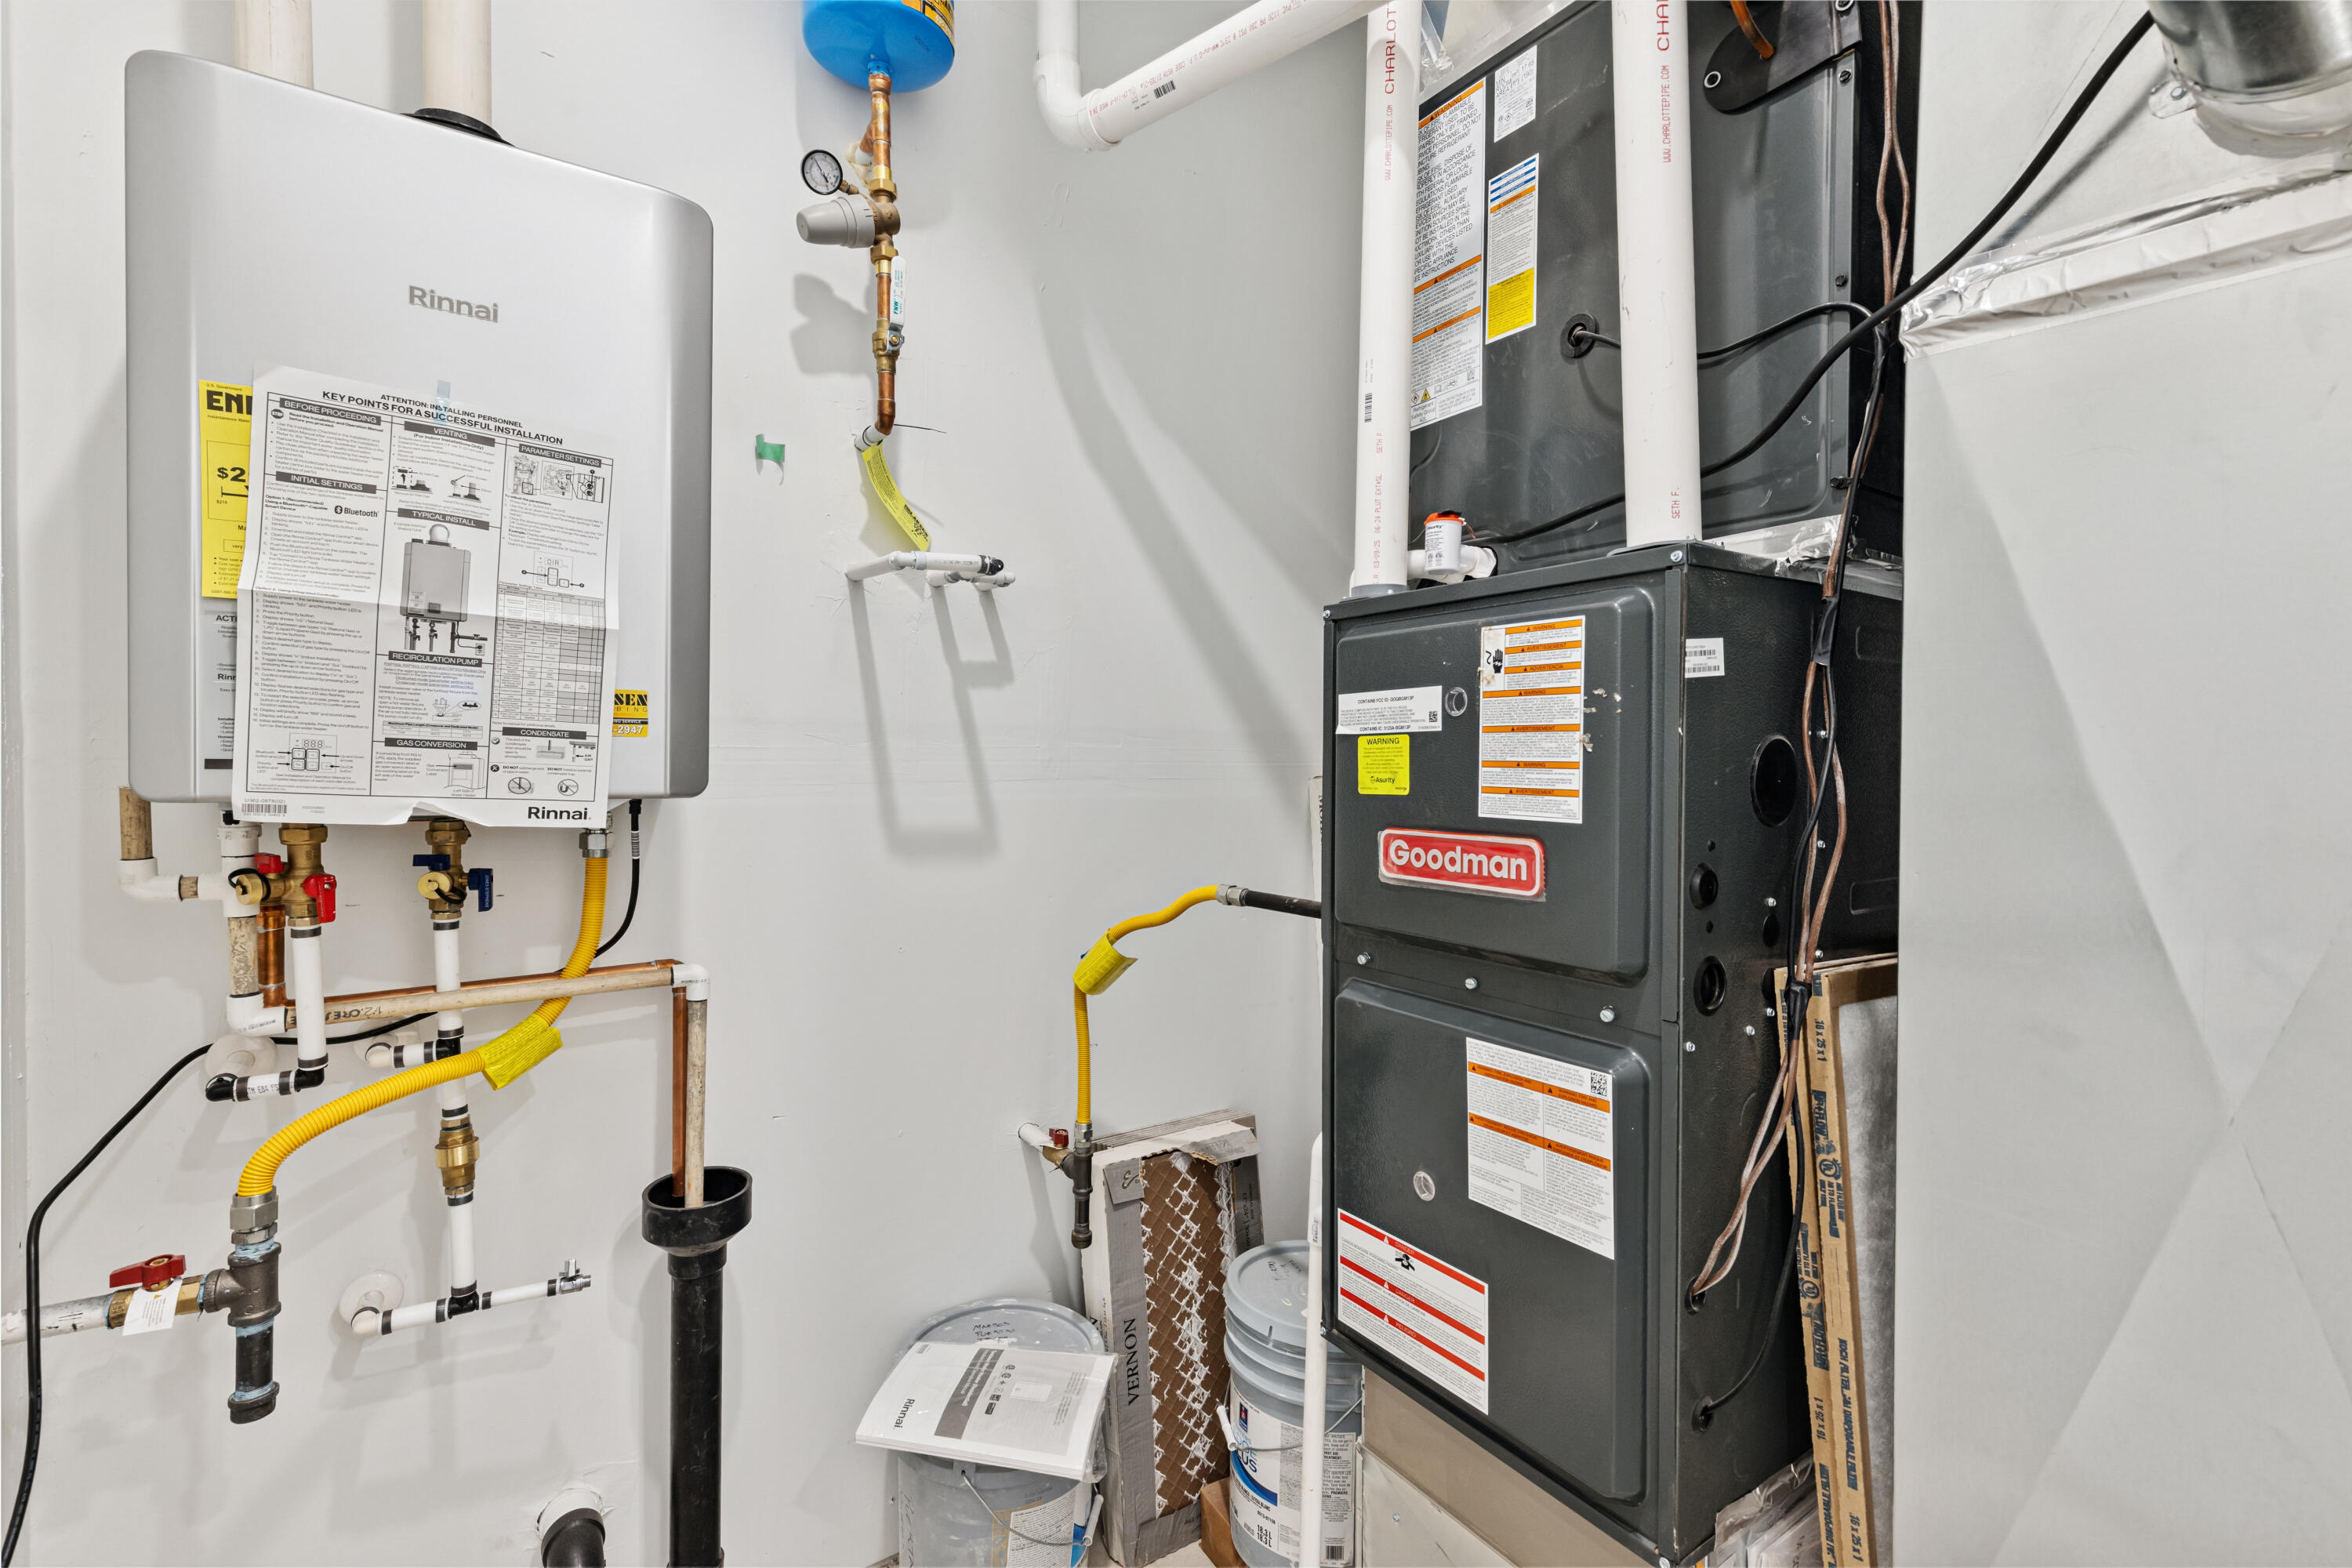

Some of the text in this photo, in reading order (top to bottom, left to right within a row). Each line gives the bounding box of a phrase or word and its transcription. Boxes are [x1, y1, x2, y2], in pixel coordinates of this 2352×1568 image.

[1656, 0, 1670, 51] CHA
[1435, 95, 1461, 116] WARNING
[1457, 109, 1477, 125] TRAINED
[1472, 114, 1481, 125] NOT
[1661, 65, 1671, 163] WWW.CHARLOTTEPIPE.COM
[1438, 129, 1470, 154] REFRIGERANT
[1444, 149, 1465, 165] DISPOSE
[1445, 167, 1472, 187] FLAMMABLE
[1454, 163, 1468, 176] LOCAL
[1432, 207, 1446, 219] WHICH
[1448, 201, 1458, 209] MAY
[1433, 201, 1471, 227] SOURCES SHALL
[1461, 209, 1470, 217] THE
[1436, 223, 1472, 248] DEVICES LISTED
[1440, 217, 1469, 238] OTHER THAN
[409, 285, 499, 323] Rinnai
[285, 401, 377, 423] BEFORE PROCEEDING
[322, 391, 346, 401] KEY
[347, 396, 390, 411] POINTS
[391, 405, 415, 416] FOR
[424, 410, 493, 431] SUCCESSFUL
[494, 426, 563, 445] INSTALLATION
[380, 394, 523, 428] ATTENTION: INSTALLING PERSONNEL
[434, 428, 467, 440] VENTING
[521, 446, 600, 466] PARAMETER SETTINGS
[291, 475, 363, 490] INITIAL SETTINGS
[343, 506, 378, 517] Bluetooth
[1671, 497, 1680, 519] SETH
[412, 510, 476, 526] TYPICAL INSTALL
[392, 653, 457, 664] RECIRCULATION
[521, 729, 570, 738] CONDENSATE
[414, 740, 466, 749] CONVERSION
[528, 806, 588, 820] Rinnai
[1389, 839, 1527, 880] Goodman
[1816, 1037, 1826, 1048] 25
[1396, 1241, 1414, 1254] DANGER
[1396, 1288, 1414, 1304] DANGER
[1396, 1322, 1417, 1338] PELIGRO
[1125, 1318, 1140, 1406] VERNON
[894, 1399, 915, 1429] Rinnai
[1814, 1410, 1824, 1422] 25
[1269, 1531, 1272, 1540] L
[1850, 1532, 1861, 1546] 25
